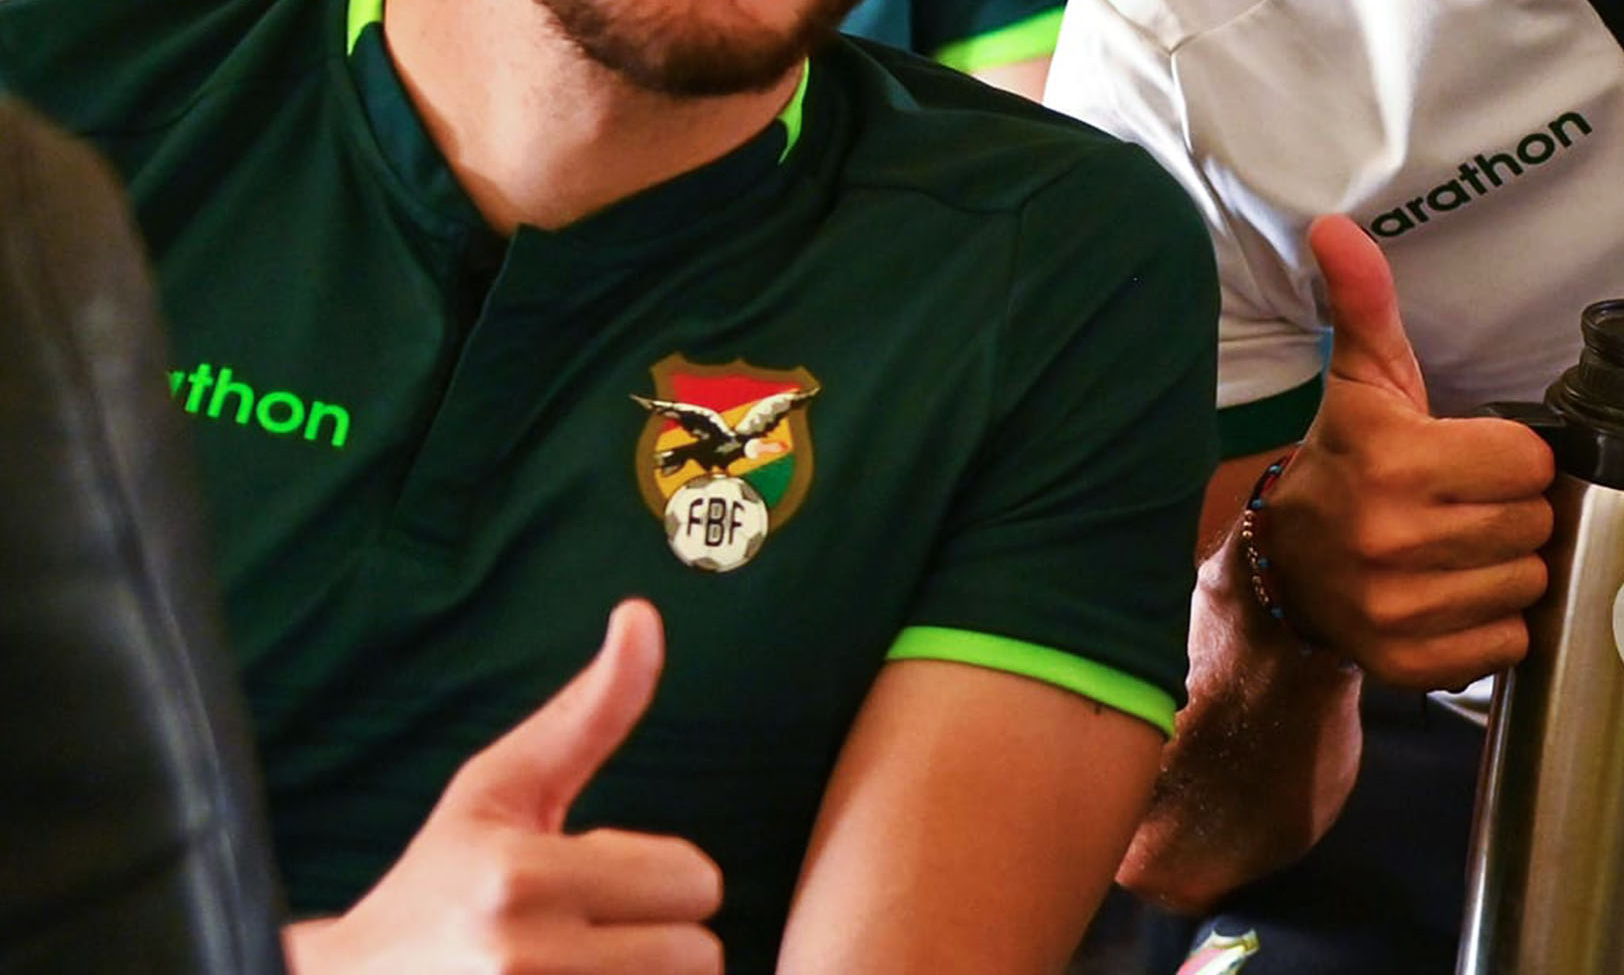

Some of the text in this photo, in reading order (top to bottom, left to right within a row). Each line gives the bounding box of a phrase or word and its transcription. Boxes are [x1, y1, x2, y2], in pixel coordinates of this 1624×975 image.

[1361, 110, 1593, 244] arathon
[167, 362, 350, 447] thon
[686, 496, 745, 547] FBF
